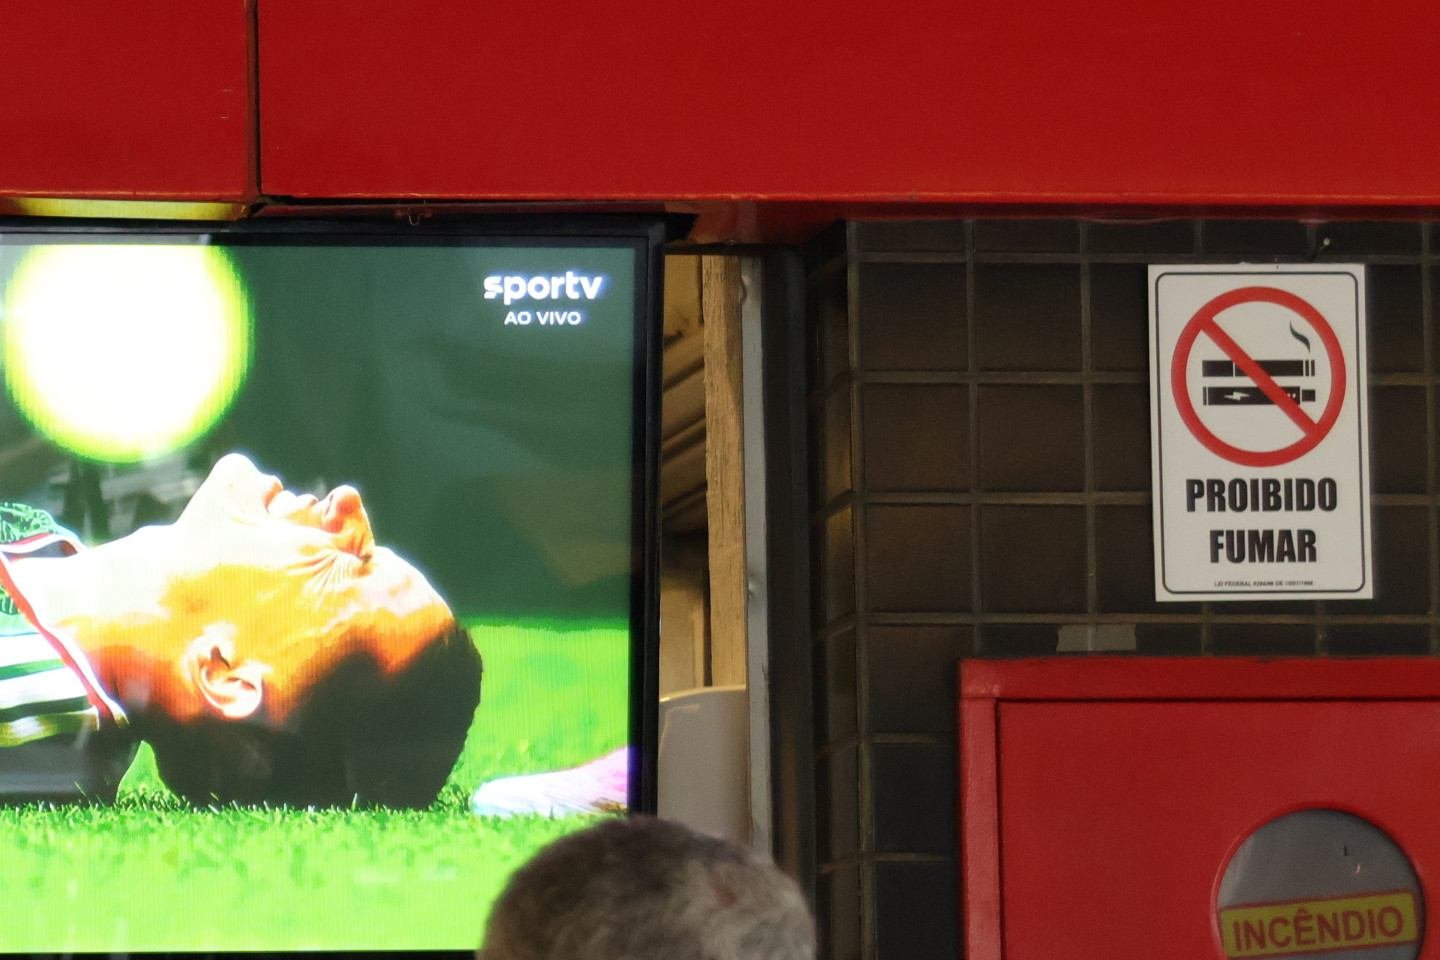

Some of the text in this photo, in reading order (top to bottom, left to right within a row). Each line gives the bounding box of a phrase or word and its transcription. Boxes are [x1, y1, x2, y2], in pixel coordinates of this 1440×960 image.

[483, 271, 603, 306] sportv
[504, 311, 582, 326] AO VIVO
[1185, 477, 1338, 513] PROIBIDO
[1209, 529, 1317, 564] FUMAR
[1232, 906, 1404, 952] INCÊNDIO
